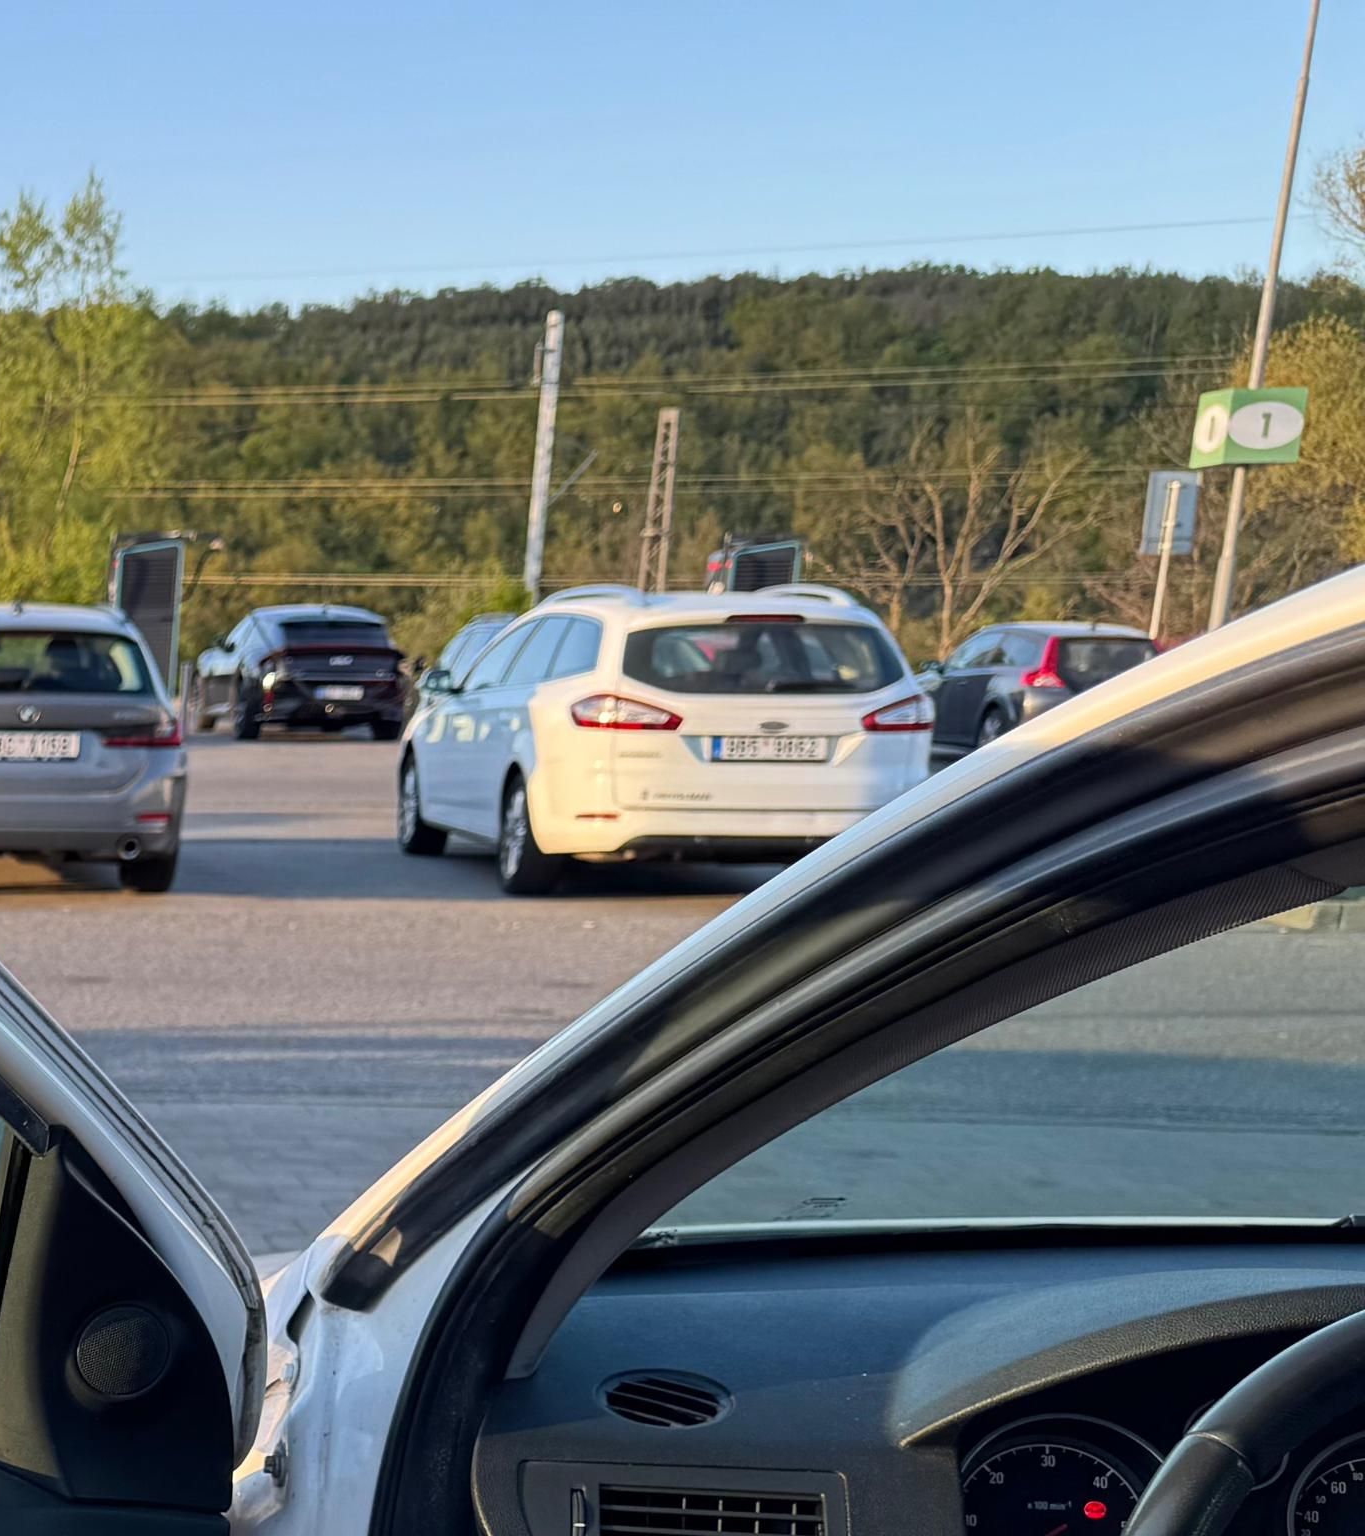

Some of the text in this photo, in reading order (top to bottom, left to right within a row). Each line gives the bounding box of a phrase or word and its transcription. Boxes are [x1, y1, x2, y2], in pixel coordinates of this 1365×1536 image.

[1261, 412, 1272, 439] 1
[1040, 1454, 1056, 1468] 30
[988, 1471, 1004, 1485] 20
[1092, 1475, 1108, 1489] 40
[1330, 1481, 1347, 1494] 60
[1303, 1510, 1319, 1523] 40
